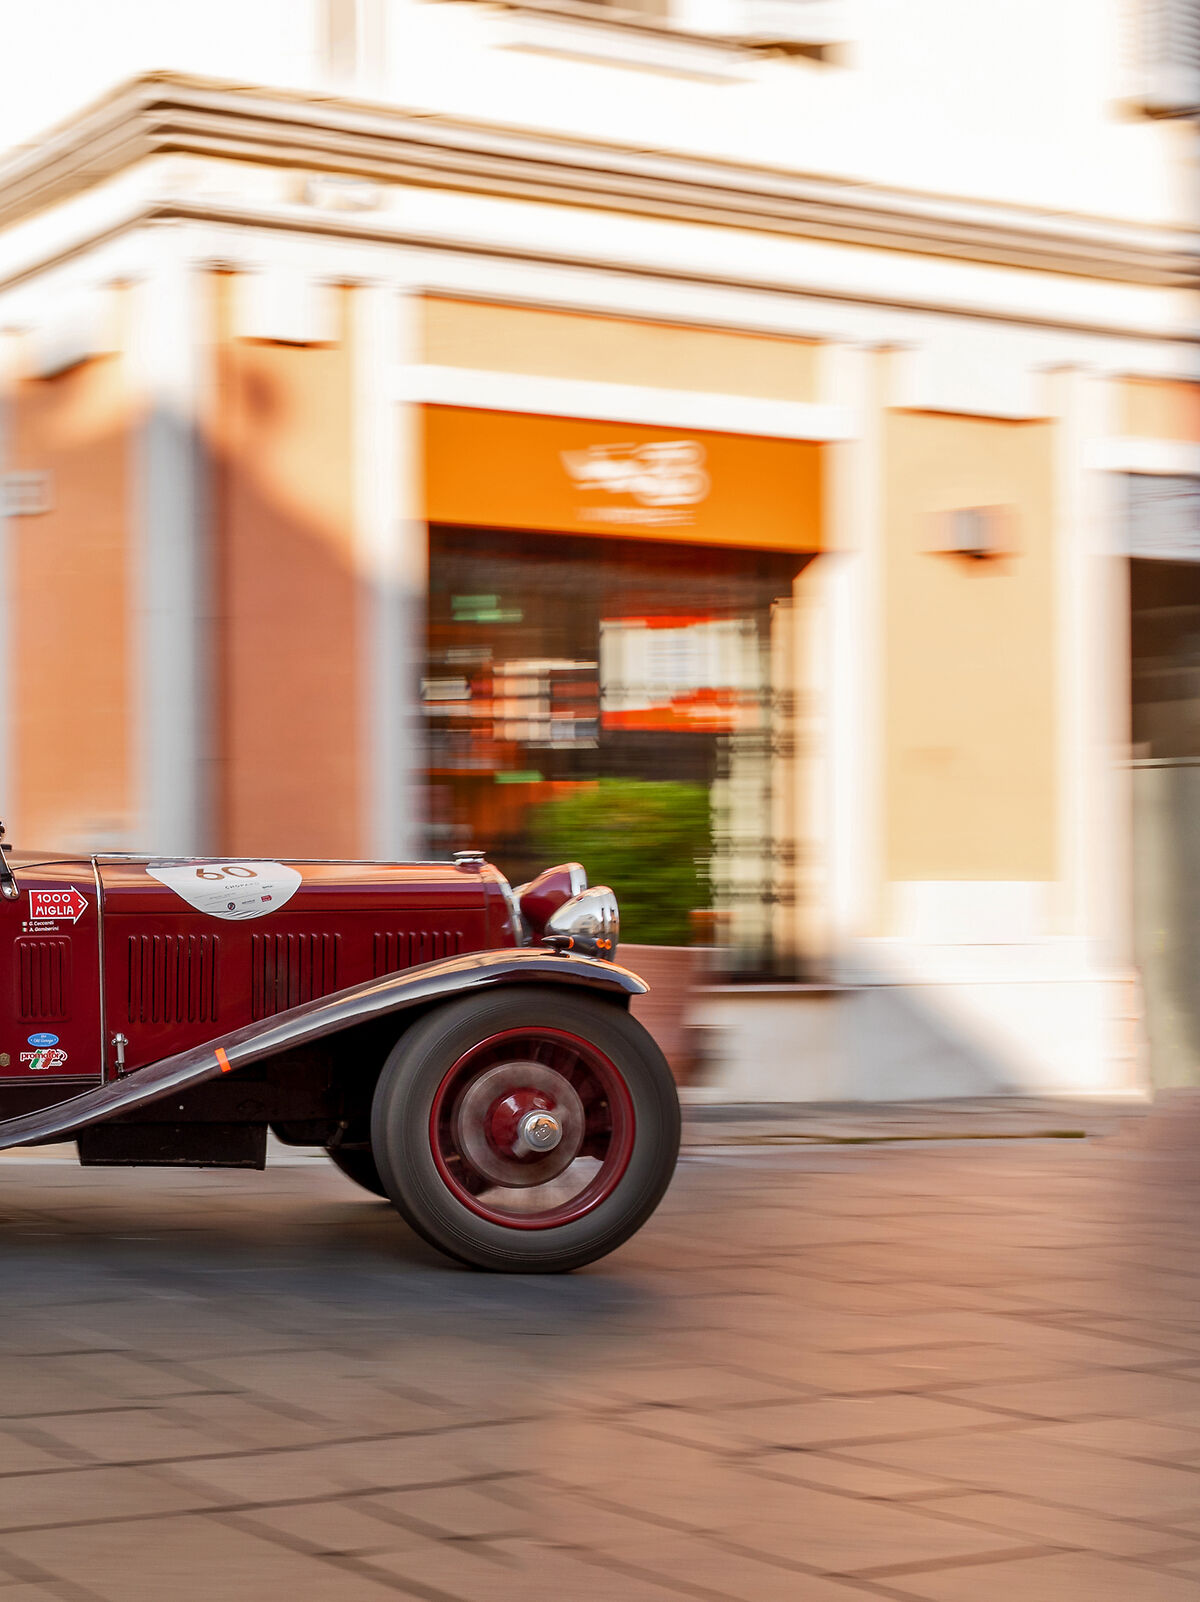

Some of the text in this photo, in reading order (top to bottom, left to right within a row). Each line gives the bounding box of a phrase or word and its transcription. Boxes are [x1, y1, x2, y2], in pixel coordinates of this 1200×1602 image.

[195, 866, 258, 881] 60
[36, 893, 71, 903] 1000
[35, 905, 74, 916] MIGLIA
